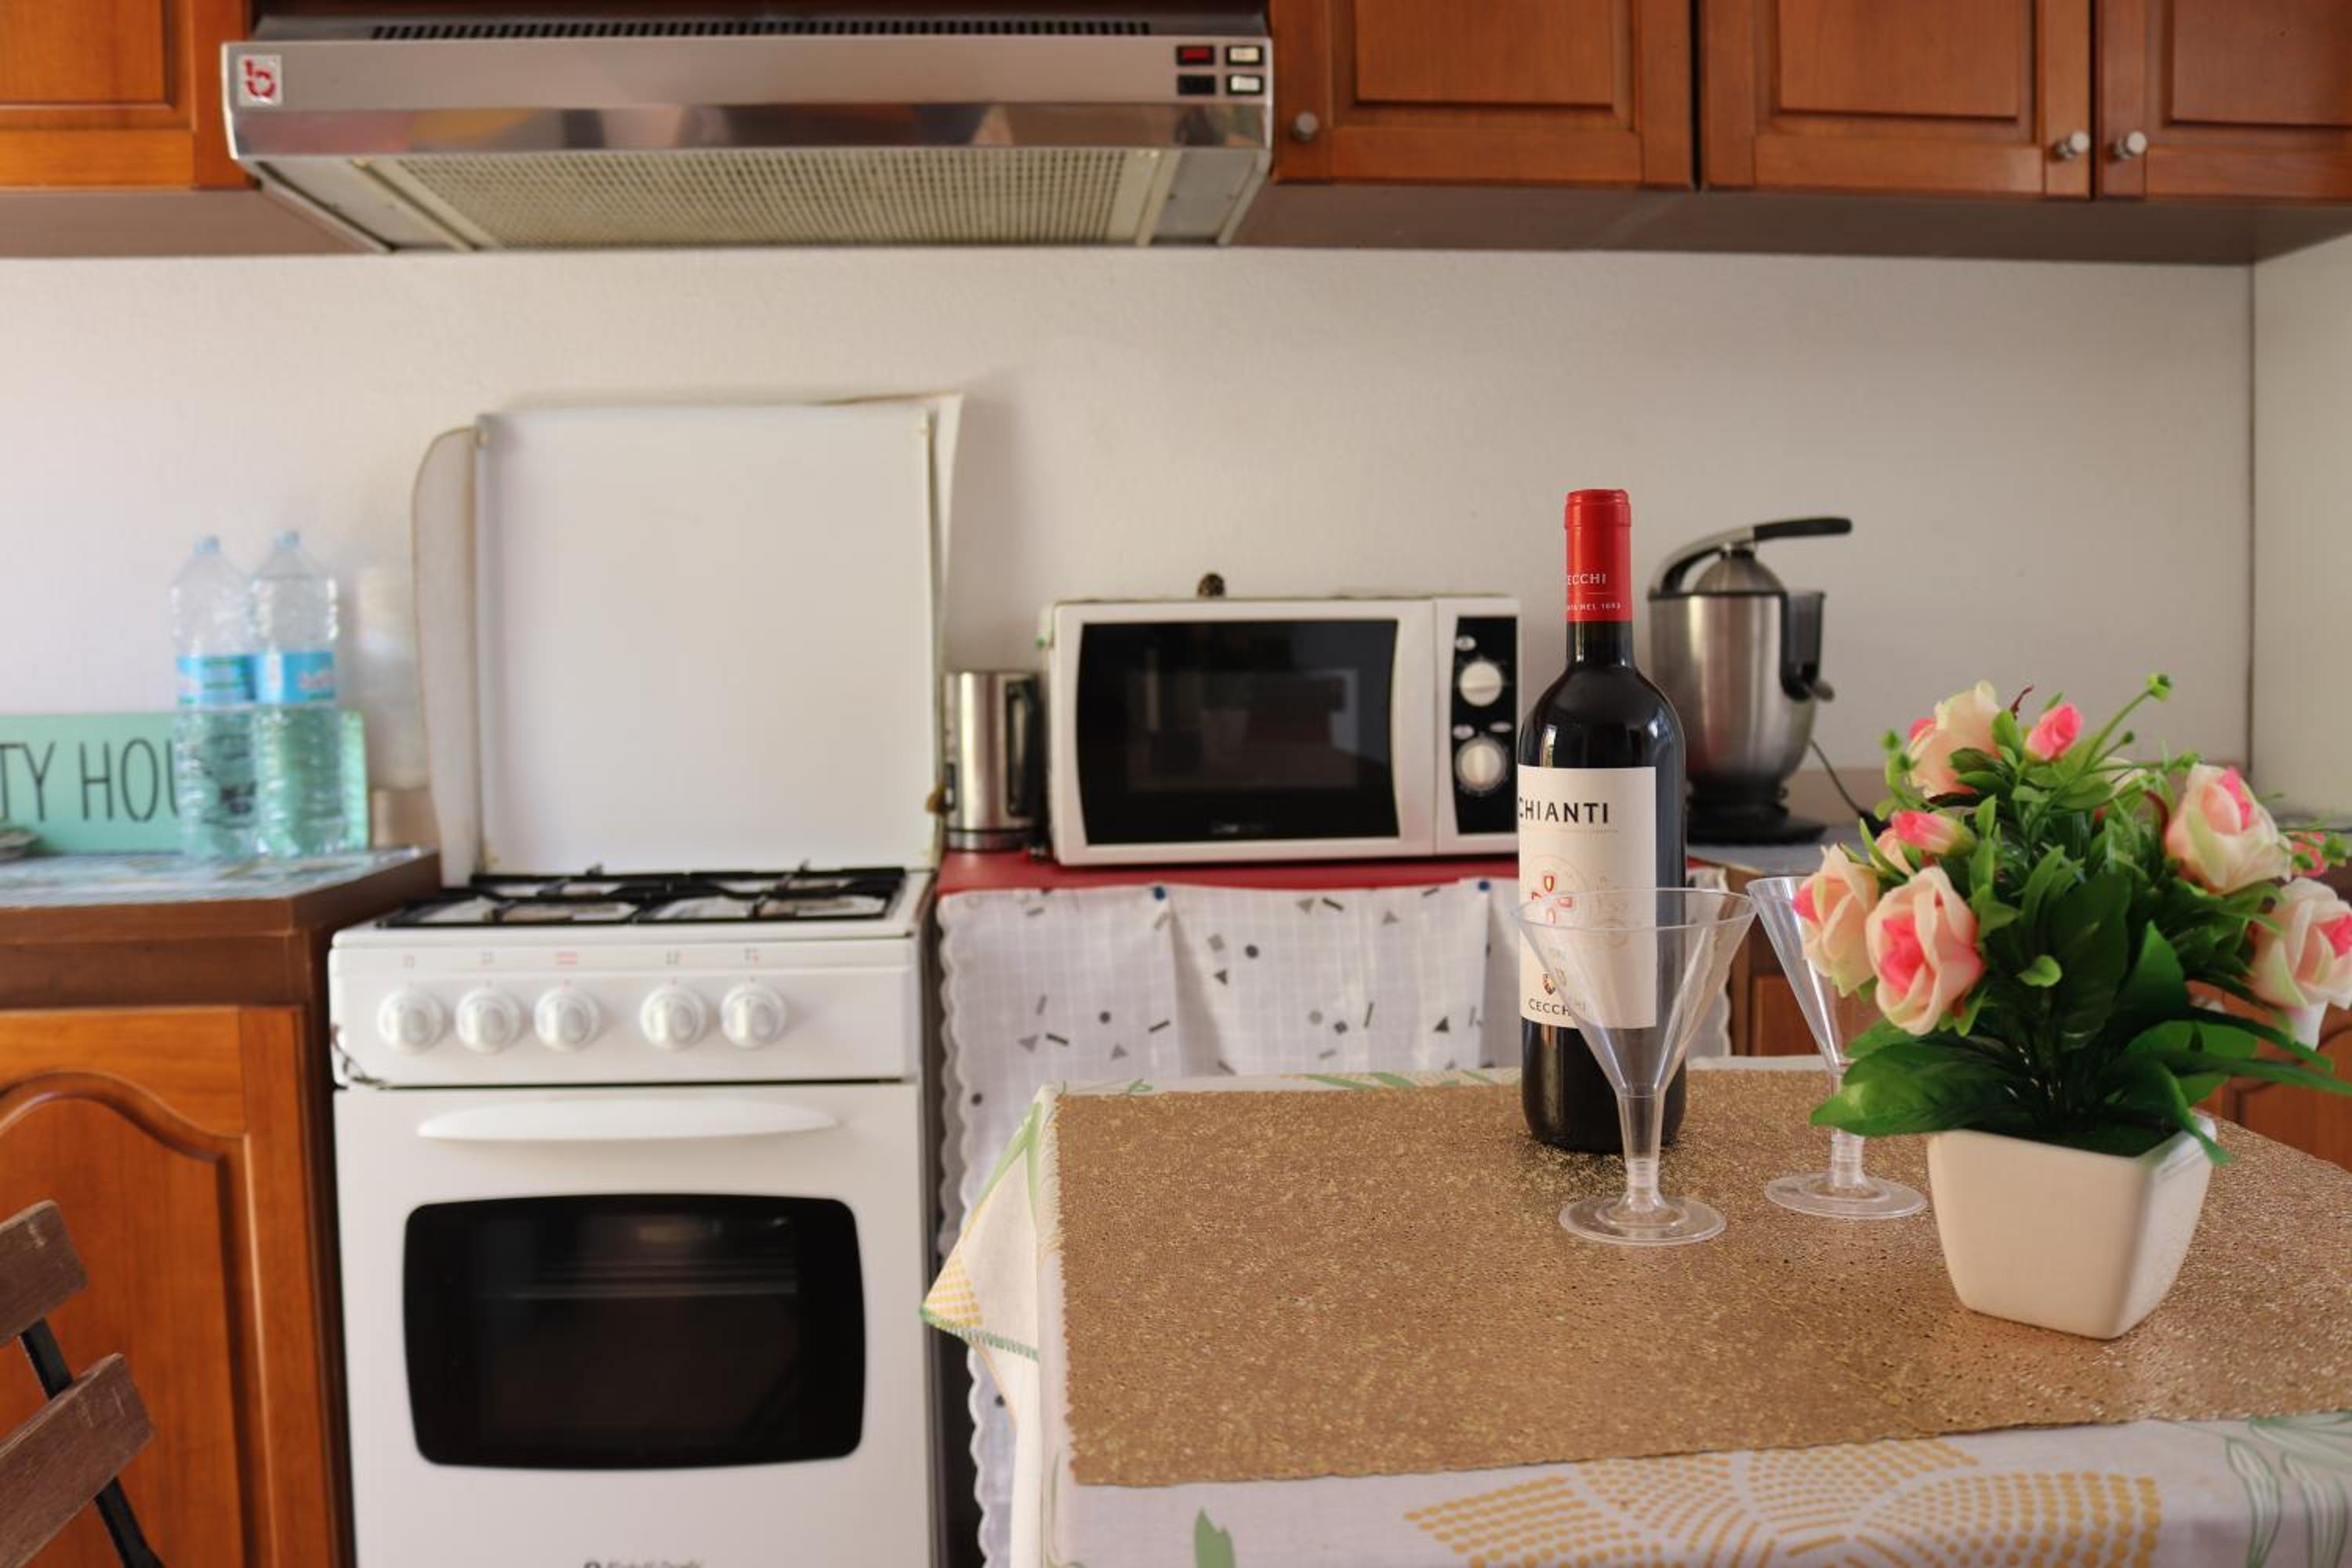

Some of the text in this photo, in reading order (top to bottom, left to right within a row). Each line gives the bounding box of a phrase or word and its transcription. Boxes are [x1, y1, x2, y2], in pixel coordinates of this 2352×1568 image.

[1567, 573, 1606, 586] ECCHI
[0, 738, 55, 822] TY
[1528, 998, 1574, 1017] CECCH
